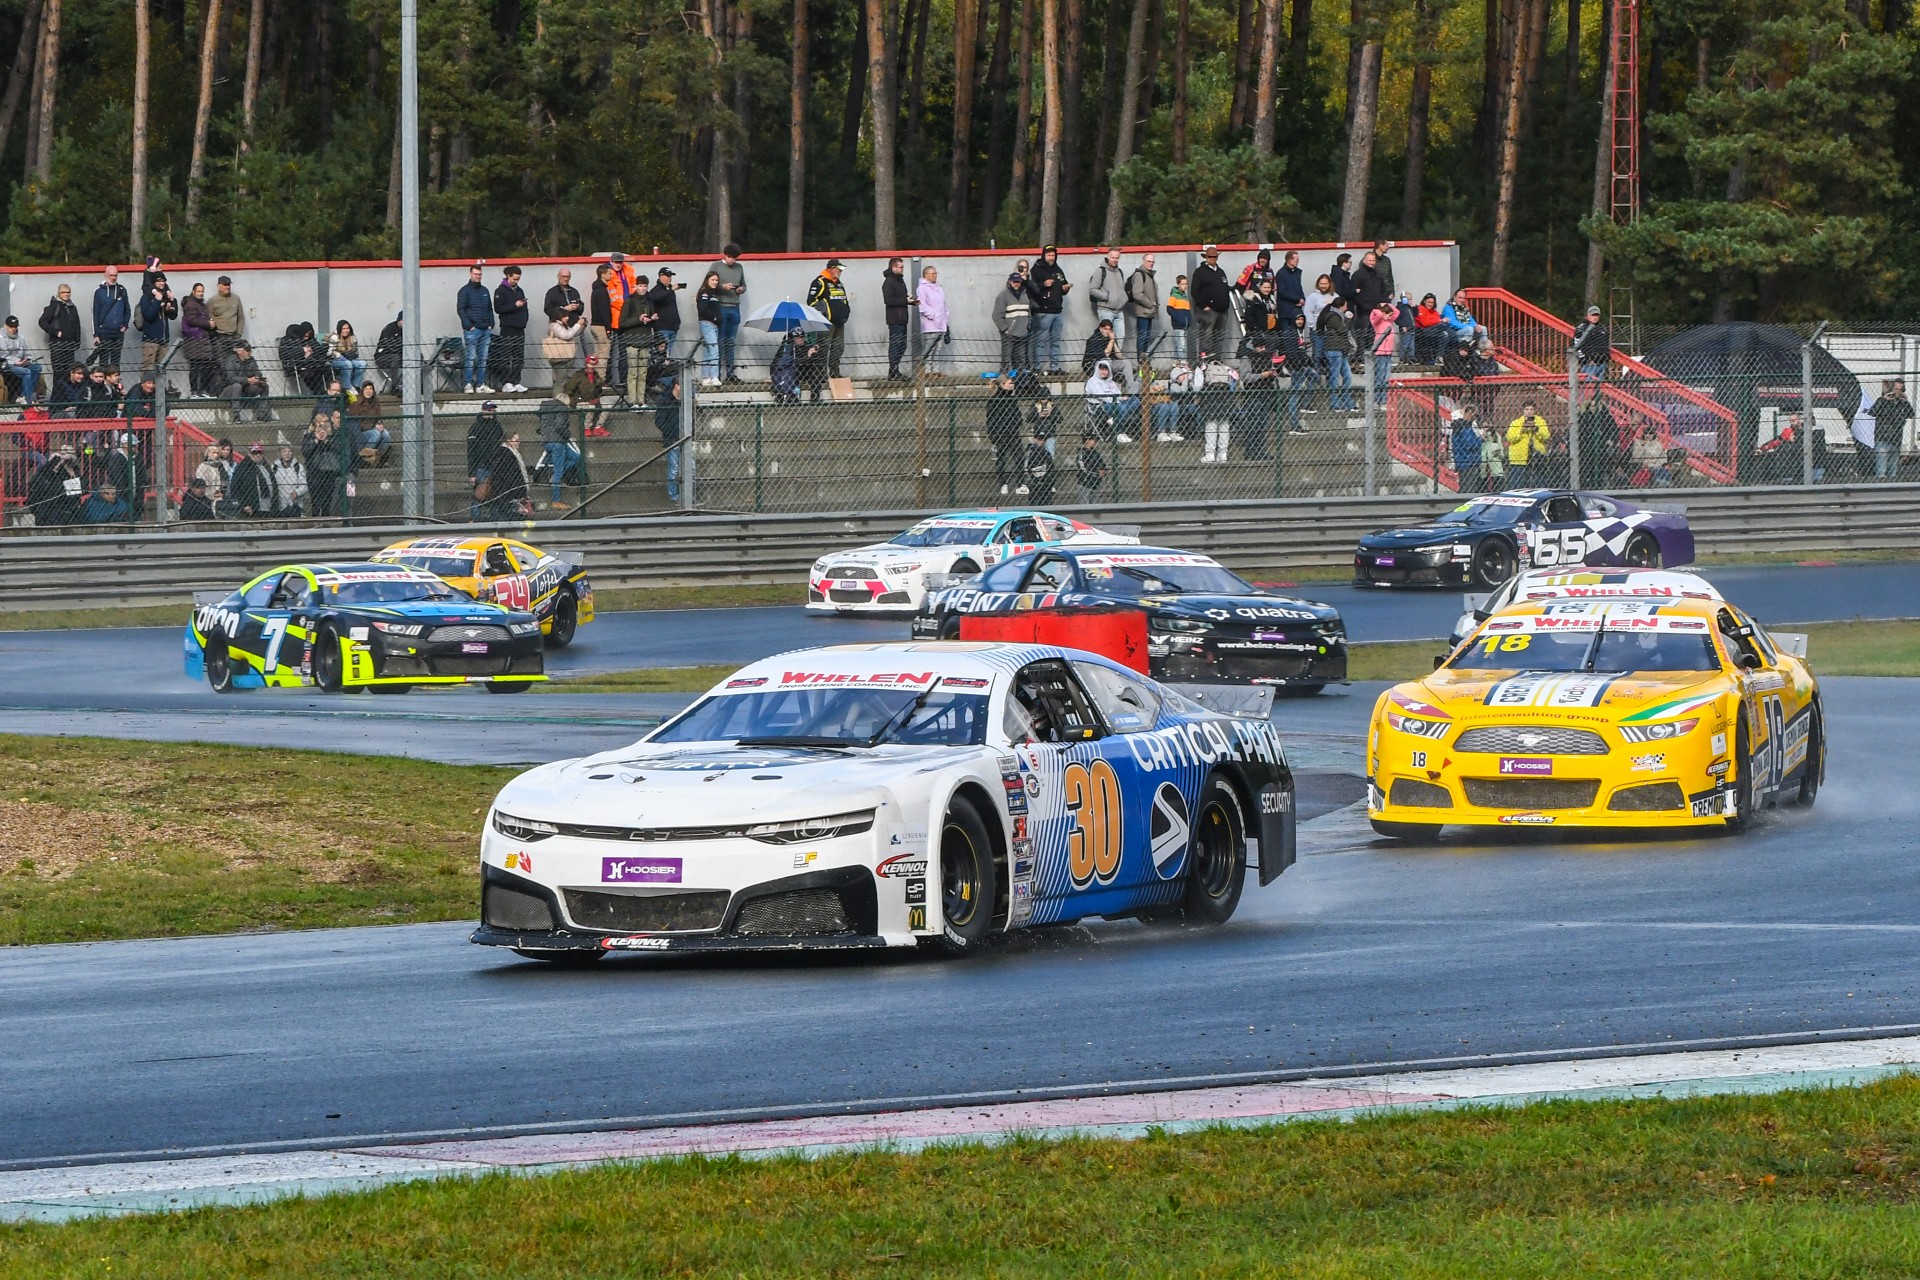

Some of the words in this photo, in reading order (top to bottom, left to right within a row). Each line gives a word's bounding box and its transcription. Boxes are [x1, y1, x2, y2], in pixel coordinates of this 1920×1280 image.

[1534, 528, 1587, 566] 66
[1563, 587, 1674, 596] WHELEN
[943, 588, 1011, 613] HEINZ
[1235, 606, 1318, 620] quatra
[1534, 617, 1660, 628] WHELEN
[261, 613, 291, 674] 7
[1170, 636, 1205, 644] HEINZ
[1216, 641, 1318, 652] www.heinz-tuning.be
[1478, 634, 1532, 654] 18
[781, 670, 934, 685] WHELEN
[1460, 712, 1610, 724] interconsulting.group
[1124, 720, 1243, 772] CRITICAL
[1231, 720, 1288, 767] PATH
[1411, 751, 1427, 768] 18
[1513, 762, 1551, 770] HOOSIER
[1261, 791, 1291, 814] SECURITY
[1064, 757, 1124, 891] 30
[505, 854, 519, 869] 30
[880, 863, 926, 874] KENNOL
[625, 866, 676, 875] HOOSIER
[606, 936, 672, 947] KENNOL
